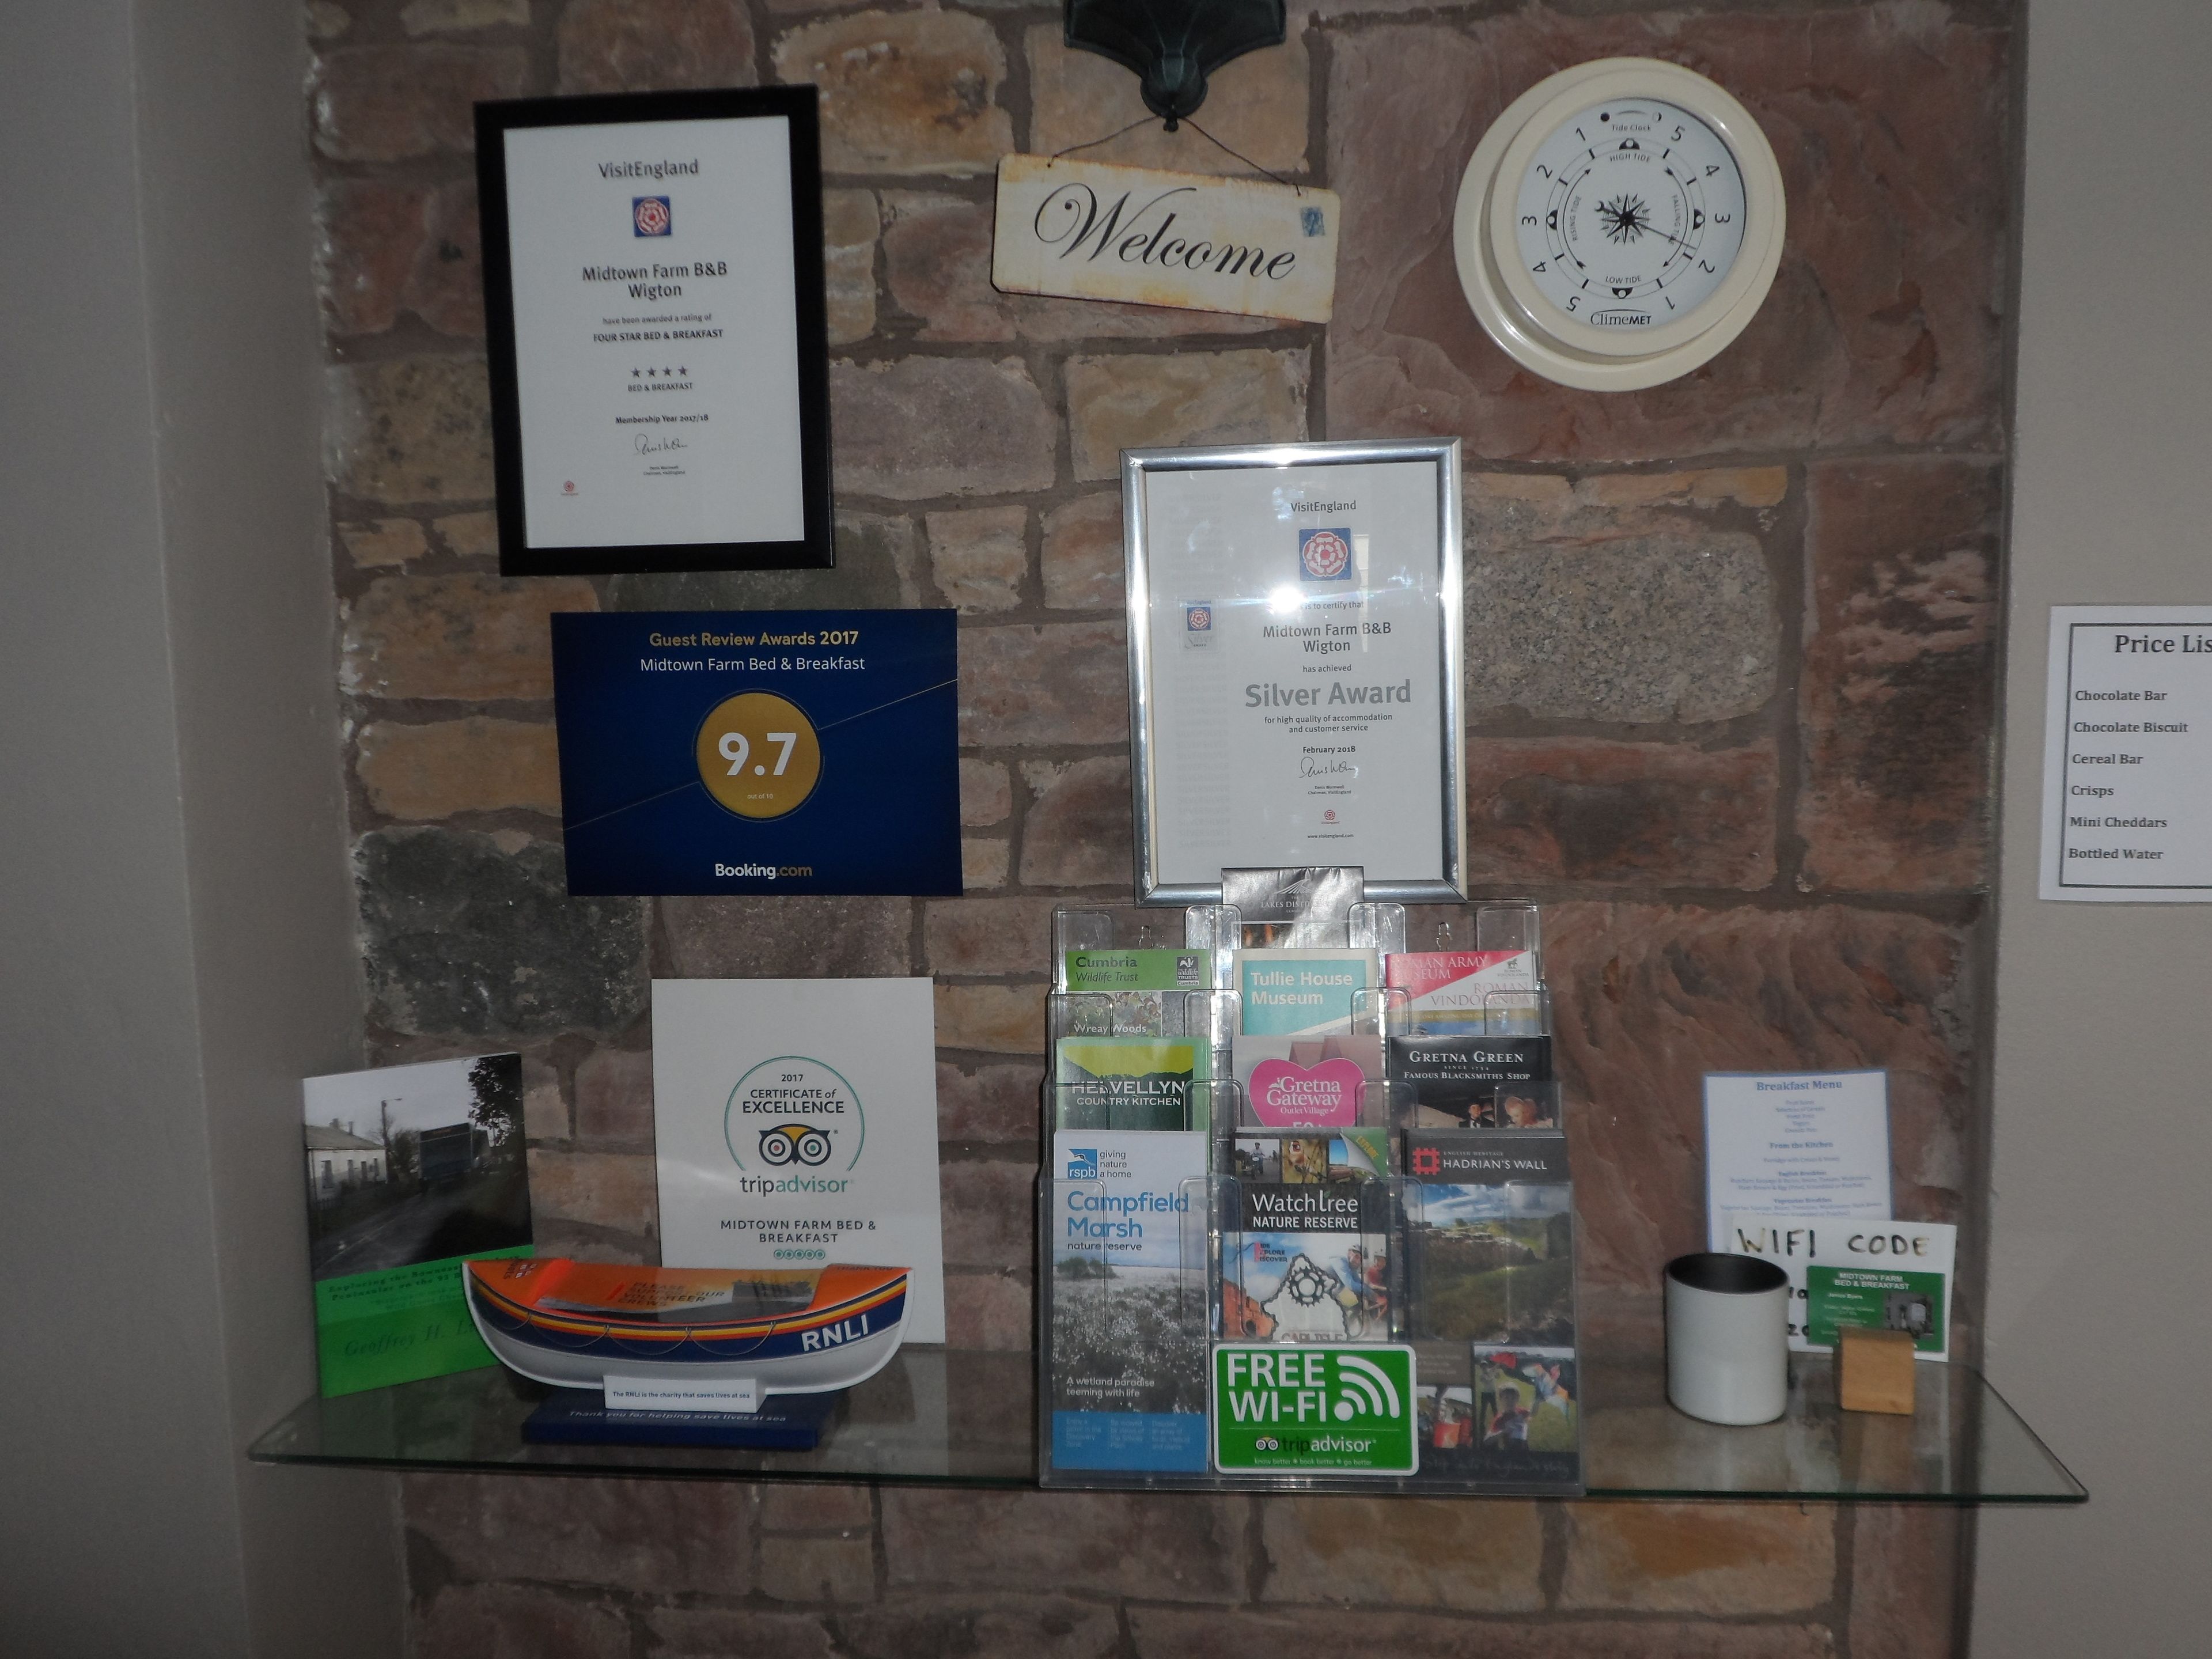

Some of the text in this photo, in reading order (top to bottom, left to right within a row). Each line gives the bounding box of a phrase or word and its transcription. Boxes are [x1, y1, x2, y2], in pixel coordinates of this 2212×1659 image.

[1609, 153, 1651, 162] HIGH TIDE
[599, 159, 699, 179] VisitEngland
[1035, 183, 1296, 279] Welcome
[582, 262, 727, 281] Midtown Farm B&B
[628, 283, 681, 300] Wigton
[1590, 313, 1652, 325] ClimeMET
[593, 329, 723, 342] FOUR STAR BED & BREAKFAST
[615, 414, 709, 425] Membership Year 2017/18
[1290, 501, 1357, 513] VisitEngland
[1323, 601, 1347, 611] certify
[1263, 622, 1392, 638] Midtown Farm B&B
[649, 631, 858, 647] Guest Review Awards 2017
[2115, 635, 2175, 653] Price
[1303, 640, 1351, 655] Wigton
[641, 657, 865, 672] Midtown Farm Bed & Breakfast
[1245, 679, 1411, 707] Silver Award
[2075, 691, 2167, 700] Chocolate Bar
[1277, 716, 1293, 725] high
[1296, 715, 1321, 724] quality
[1332, 713, 1392, 722] accommodation
[2074, 722, 2188, 733] Chocolate Biscuit
[718, 732, 797, 776] 9.7
[1303, 747, 1335, 755] February
[2073, 754, 2143, 764] Cereal Bar
[2071, 786, 2114, 798] Crisps
[2070, 817, 2167, 828] Mini Cheddars
[2069, 849, 2163, 859] Bottled Water
[715, 863, 813, 880] Booking.com
[1075, 956, 1138, 968] Cumbria
[1448, 956, 1487, 968] ARMY
[1076, 972, 1138, 983] Wildlife Trust
[1251, 972, 1353, 986] Tullie House
[1474, 982, 1528, 994] ROMAN
[1251, 992, 1323, 1005] Museum
[1074, 1024, 1146, 1035] Wreay Woods
[1410, 1051, 1523, 1063] GRETNA GREEN
[1072, 1081, 1185, 1094] HELVELLYN
[1280, 1077, 1340, 1092] Gretna
[1756, 1081, 1842, 1090] Breakfast Menu
[750, 1089, 836, 1098] CERTIFICATE of
[743, 1101, 844, 1113] EXCELLENCE
[1132, 1097, 1180, 1105] KITCHEN
[1267, 1094, 1340, 1112] Gateway
[1304, 1107, 1328, 1115] Village
[1100, 1151, 1126, 1160] giving
[1444, 1160, 1547, 1169] HADRIAN'S WALL
[1069, 1167, 1095, 1179] rspb
[740, 1175, 849, 1197] tripadvisor
[1067, 1191, 1188, 1217] Campfield
[721, 1220, 876, 1230] MIDTOWN FARM BED &
[1067, 1217, 1142, 1237] Marsh
[1253, 1217, 1358, 1228] NATURE RESERVE
[759, 1233, 838, 1243] BREAKFAST
[1737, 1228, 1930, 1258] WIFI CODE
[1839, 1272, 1878, 1281] MIDTOWN
[1861, 1281, 1910, 1290] BREAKFAST
[801, 1314, 869, 1352] RNLI
[1228, 1353, 1325, 1387] FREE
[1066, 1377, 1154, 1387] A wetland paradise
[1067, 1389, 1103, 1399] teeming
[1126, 1389, 1139, 1397] life
[1228, 1391, 1325, 1422] WI-FI
[1282, 1435, 1372, 1456] tripadvisor
